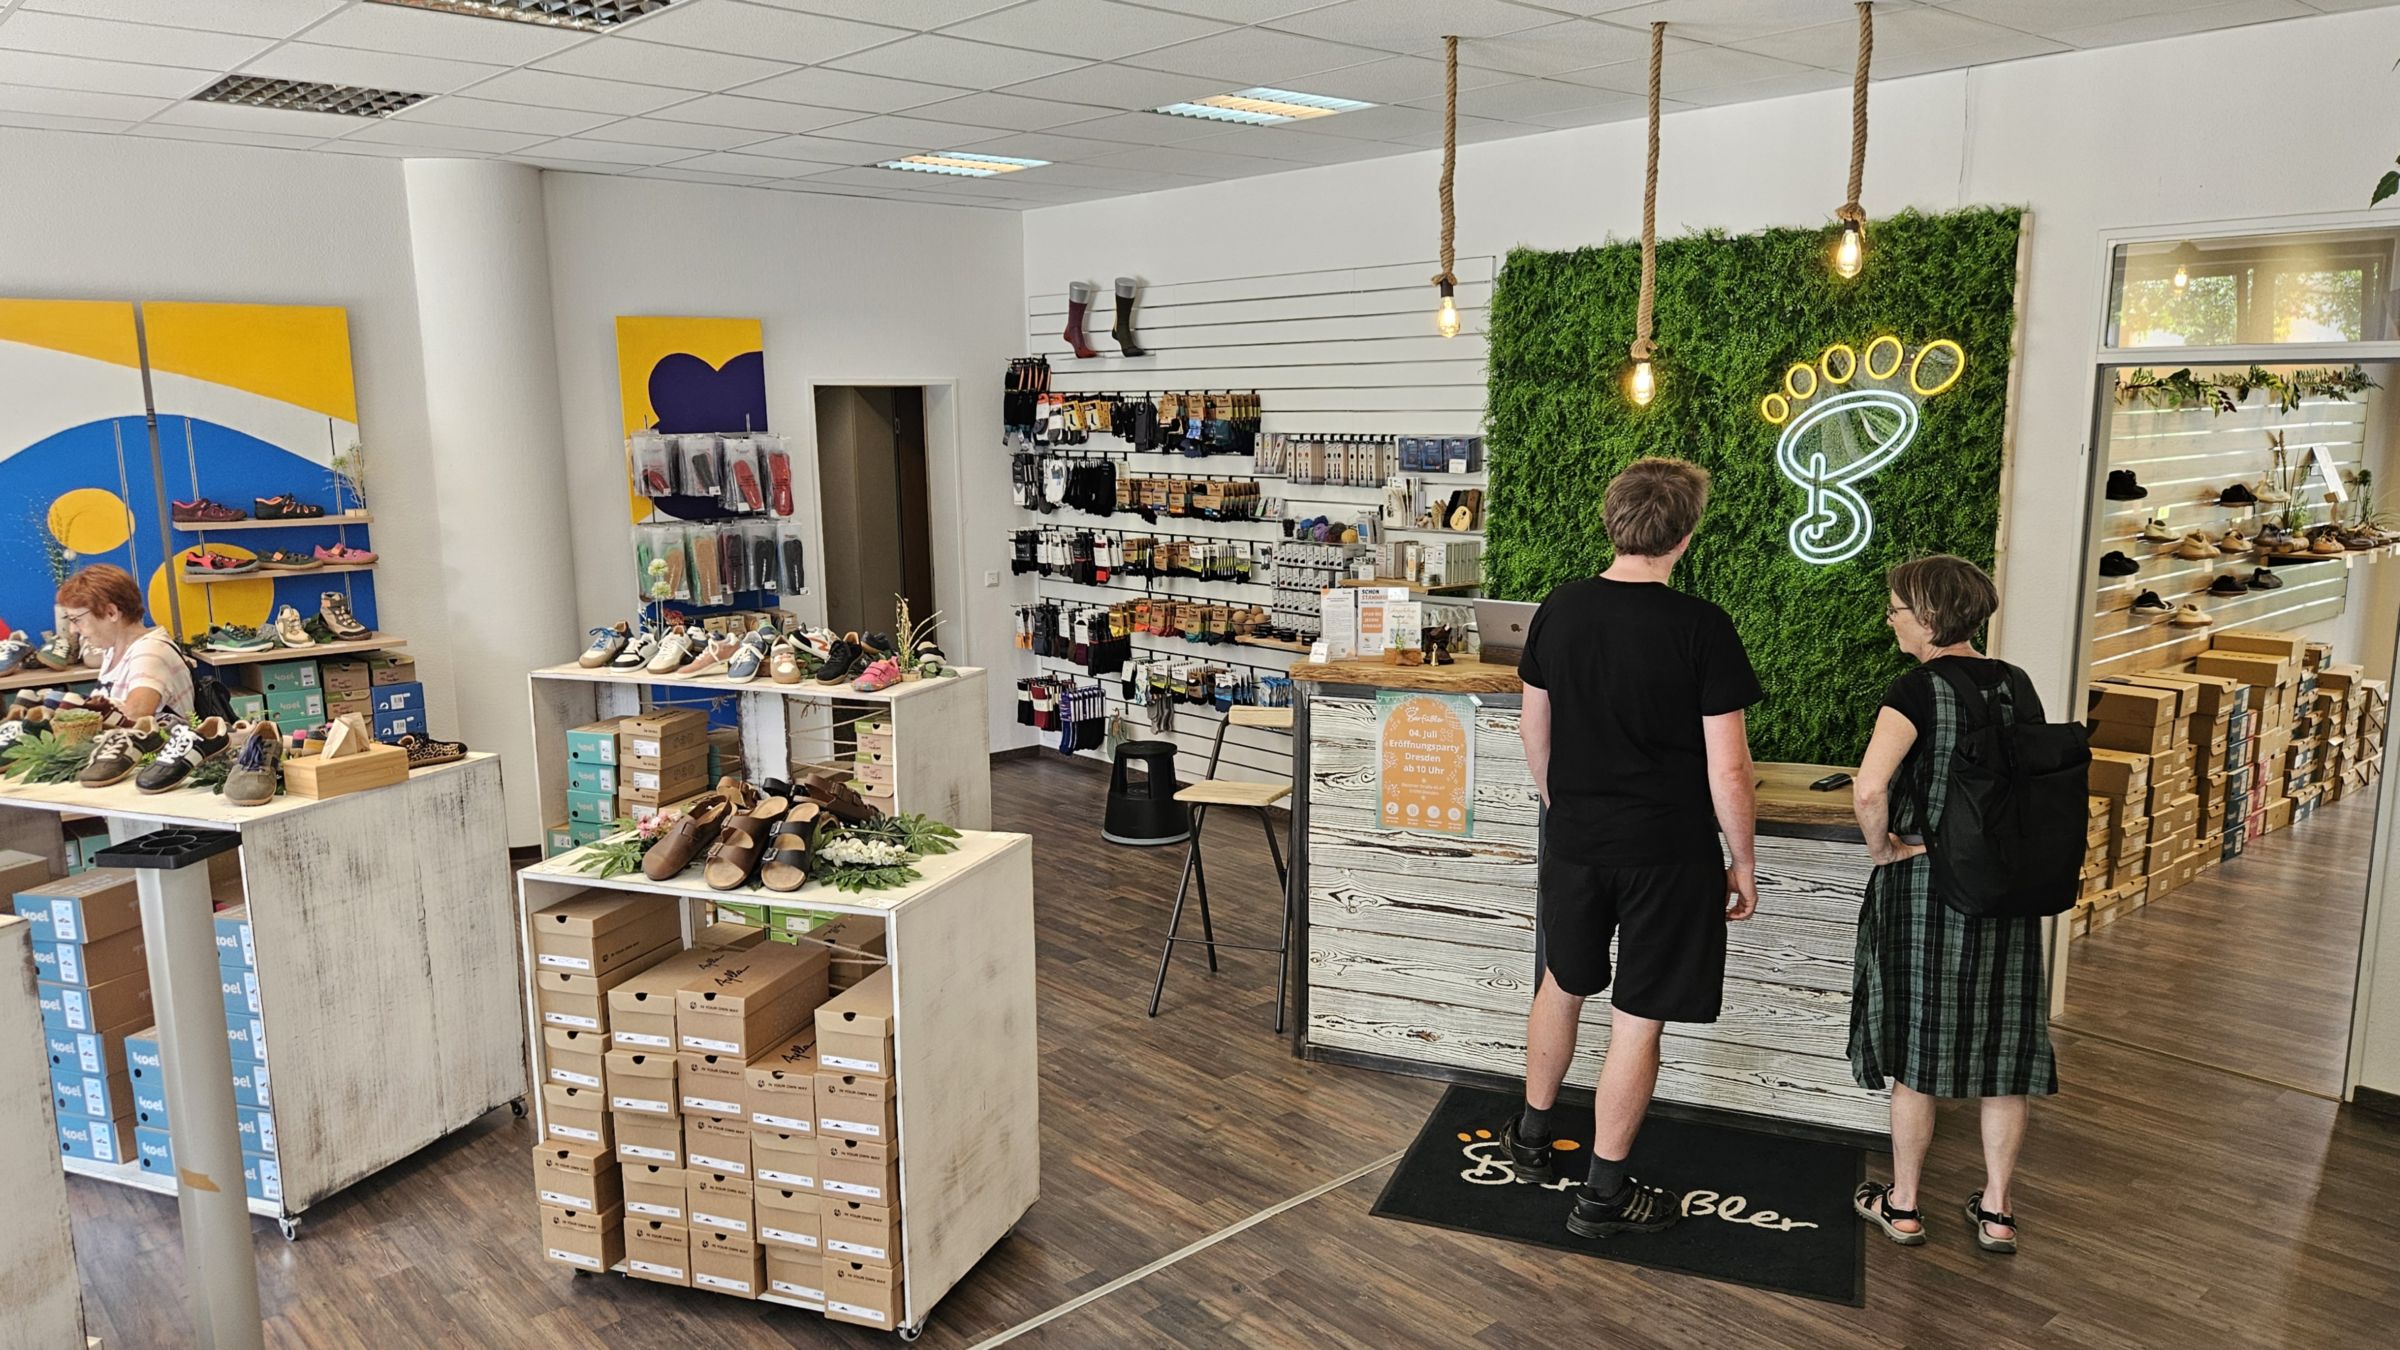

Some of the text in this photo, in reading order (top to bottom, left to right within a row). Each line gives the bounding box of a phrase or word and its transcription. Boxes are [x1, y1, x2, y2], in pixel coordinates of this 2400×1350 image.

[1408, 729, 1438, 739] 04. Juli
[1389, 740, 1460, 754] Eröffnungsparty
[1405, 752, 1440, 762] Dresden
[1428, 767, 1445, 775] Uhr
[222, 982, 242, 995] oel
[226, 1028, 248, 1042] oel
[51, 1039, 76, 1054] koel
[132, 1051, 160, 1067] koel
[232, 1075, 252, 1088] oel
[57, 1082, 82, 1097] koel
[138, 1096, 164, 1112] koel
[62, 1126, 88, 1142] koel
[142, 1141, 168, 1158] koel
